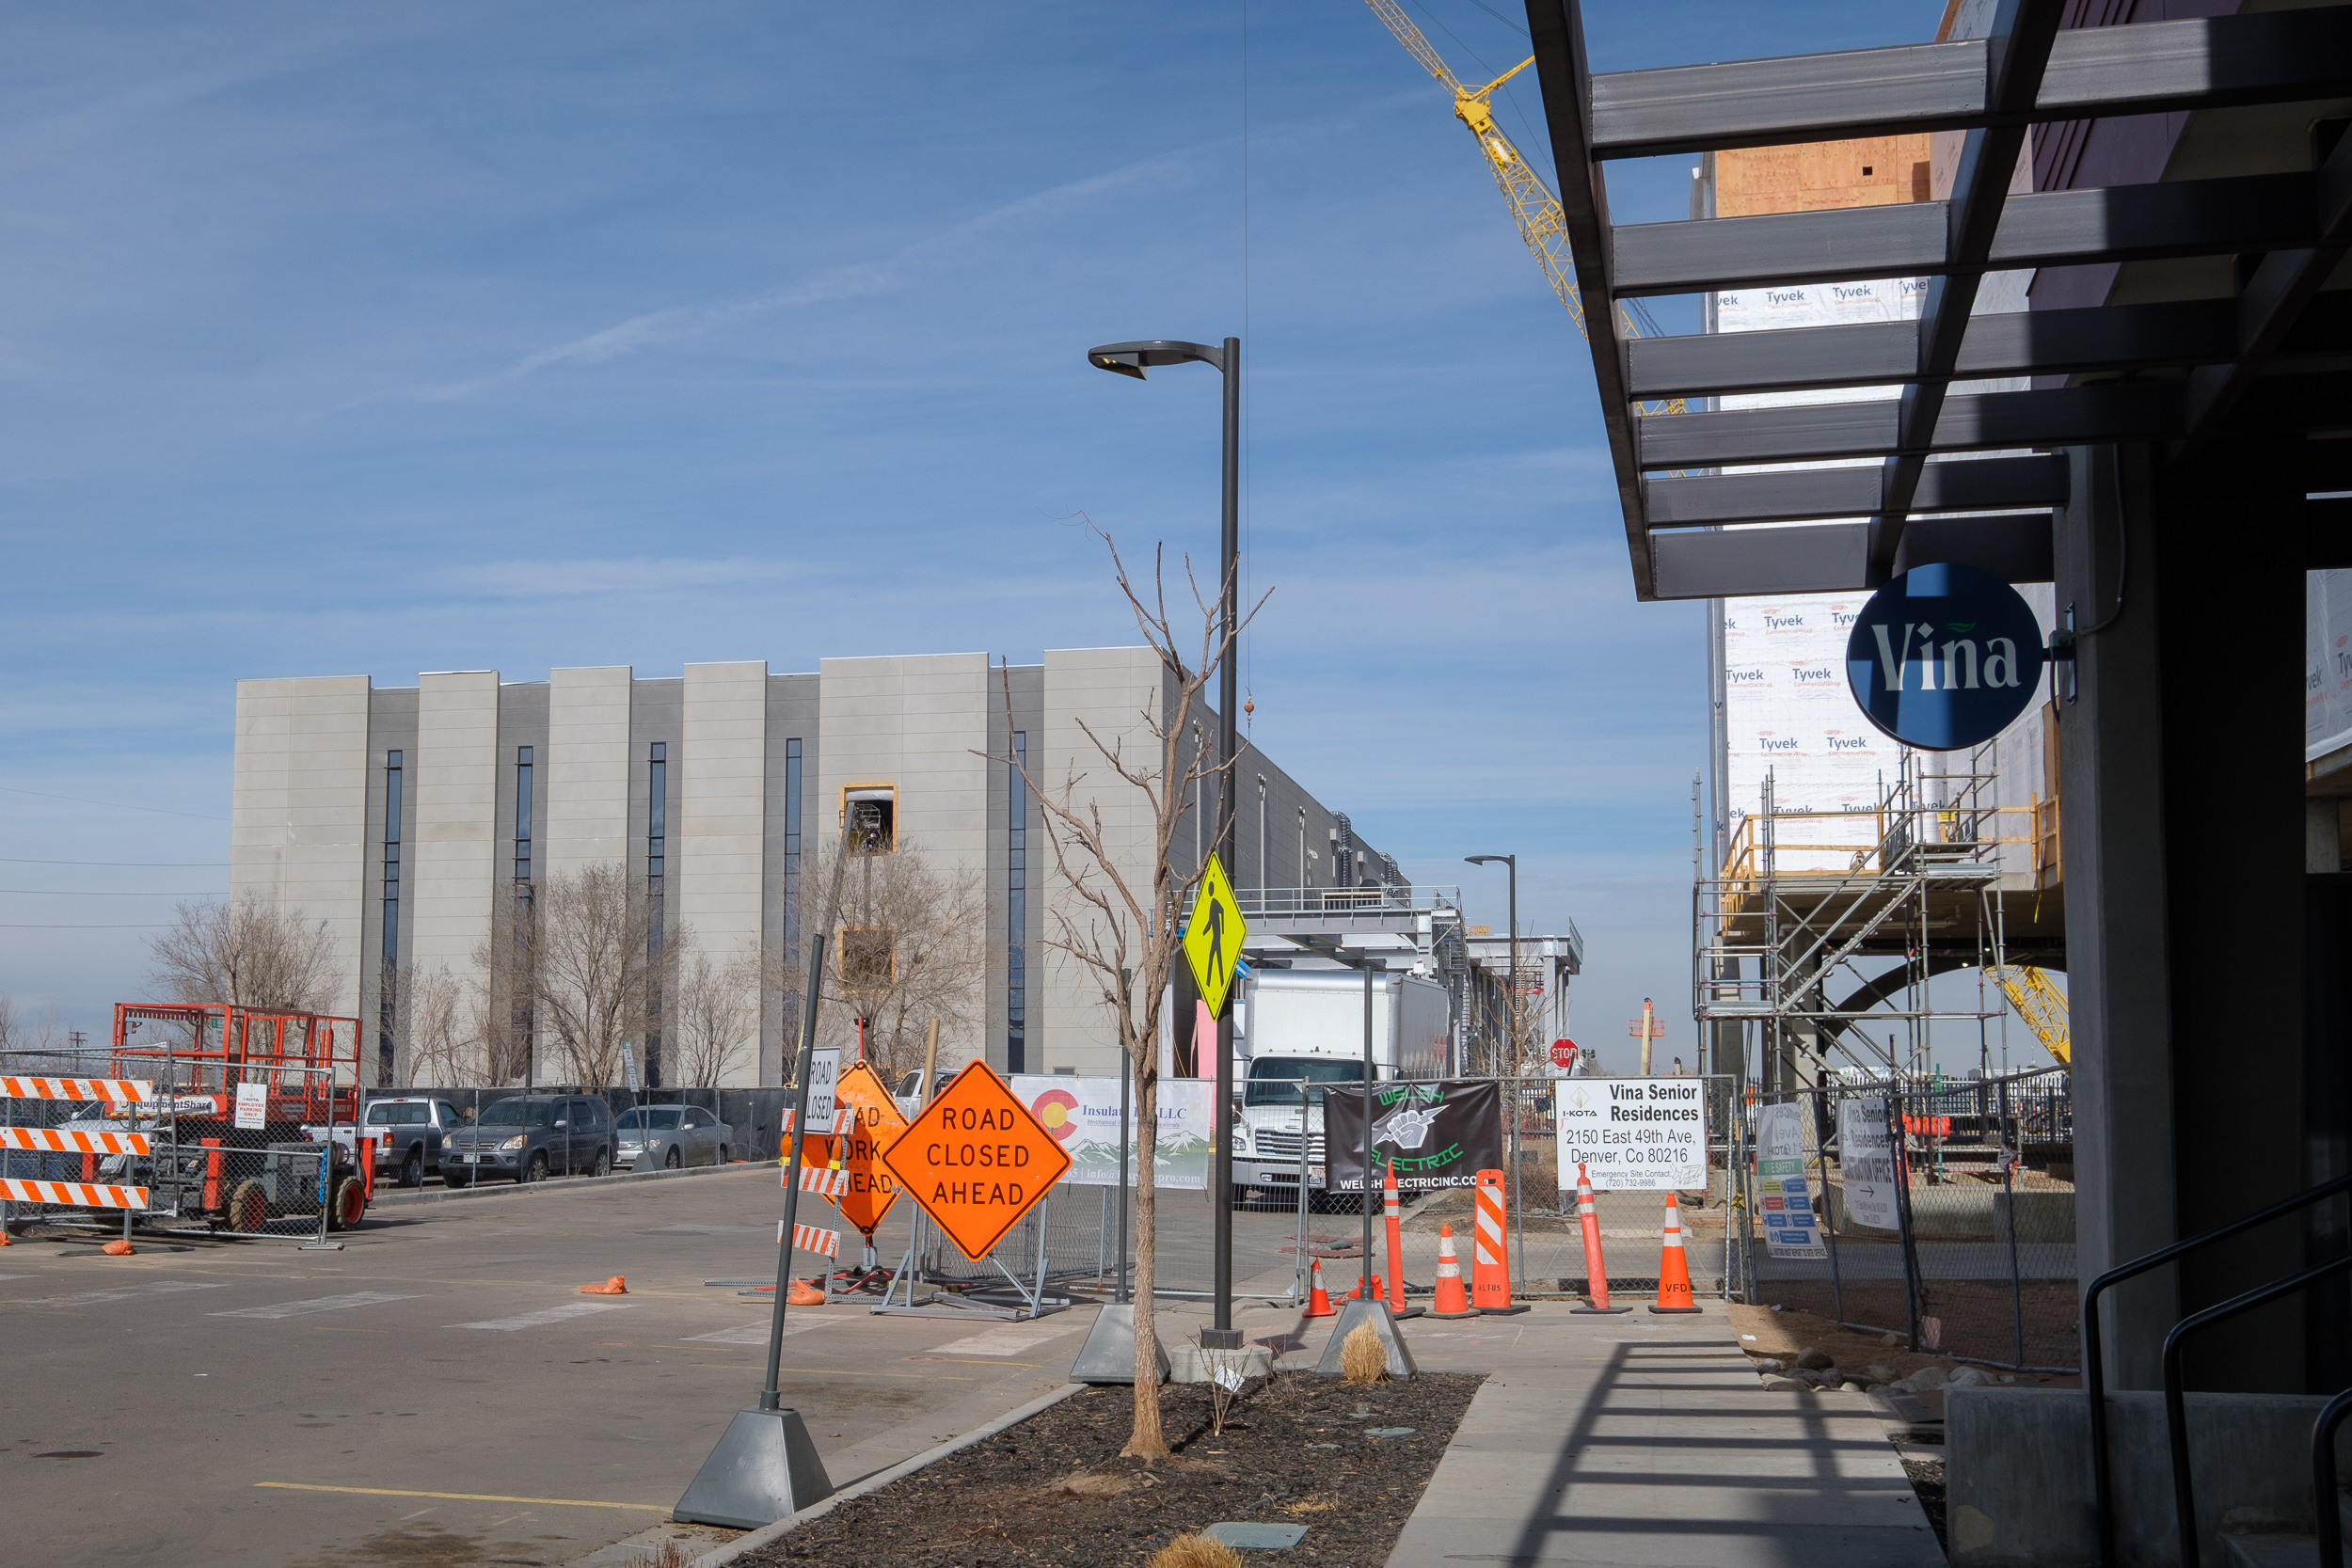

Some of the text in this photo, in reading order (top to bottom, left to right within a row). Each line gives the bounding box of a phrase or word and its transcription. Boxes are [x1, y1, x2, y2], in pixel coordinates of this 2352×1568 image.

[1766, 290, 1804, 304] Tyvek
[1833, 285, 1871, 299] Tyvek
[1718, 294, 1738, 306] vek
[1764, 614, 1804, 629] Tyvek
[1726, 669, 1763, 683] Tyvek
[1792, 668, 1831, 682] Tyvek
[2307, 664, 2322, 690] vek
[1759, 738, 1798, 751] Tyvek
[1827, 736, 1867, 750] Tyvek
[1552, 1047, 1577, 1059] STOP
[810, 1060, 832, 1085] ROAD
[1378, 1086, 1445, 1106] WELSH
[1609, 1084, 1697, 1101] Vina Senior
[806, 1096, 832, 1119] LOSED
[1083, 1104, 1122, 1117] Insulat
[1159, 1107, 1187, 1119] LLC
[1611, 1105, 1698, 1121] Residences
[854, 1106, 881, 1127] AD
[943, 1107, 1015, 1131] ROAD
[1566, 1129, 1696, 1145] 2150 East 49th Ave,
[927, 1143, 1029, 1167] CLOSED
[1571, 1148, 1688, 1164] Denver, Co 80216
[1591, 1170, 1628, 1179] Emergency
[1764, 1161, 1796, 1173] SITE SAFETY
[848, 1173, 893, 1194] EAD
[1340, 1175, 1488, 1190] WELHECTRICINC.CO
[1605, 1179, 1656, 1188] (720) 732-9986
[931, 1181, 1024, 1205] AHEAD
[1665, 1283, 1687, 1292] VFD
